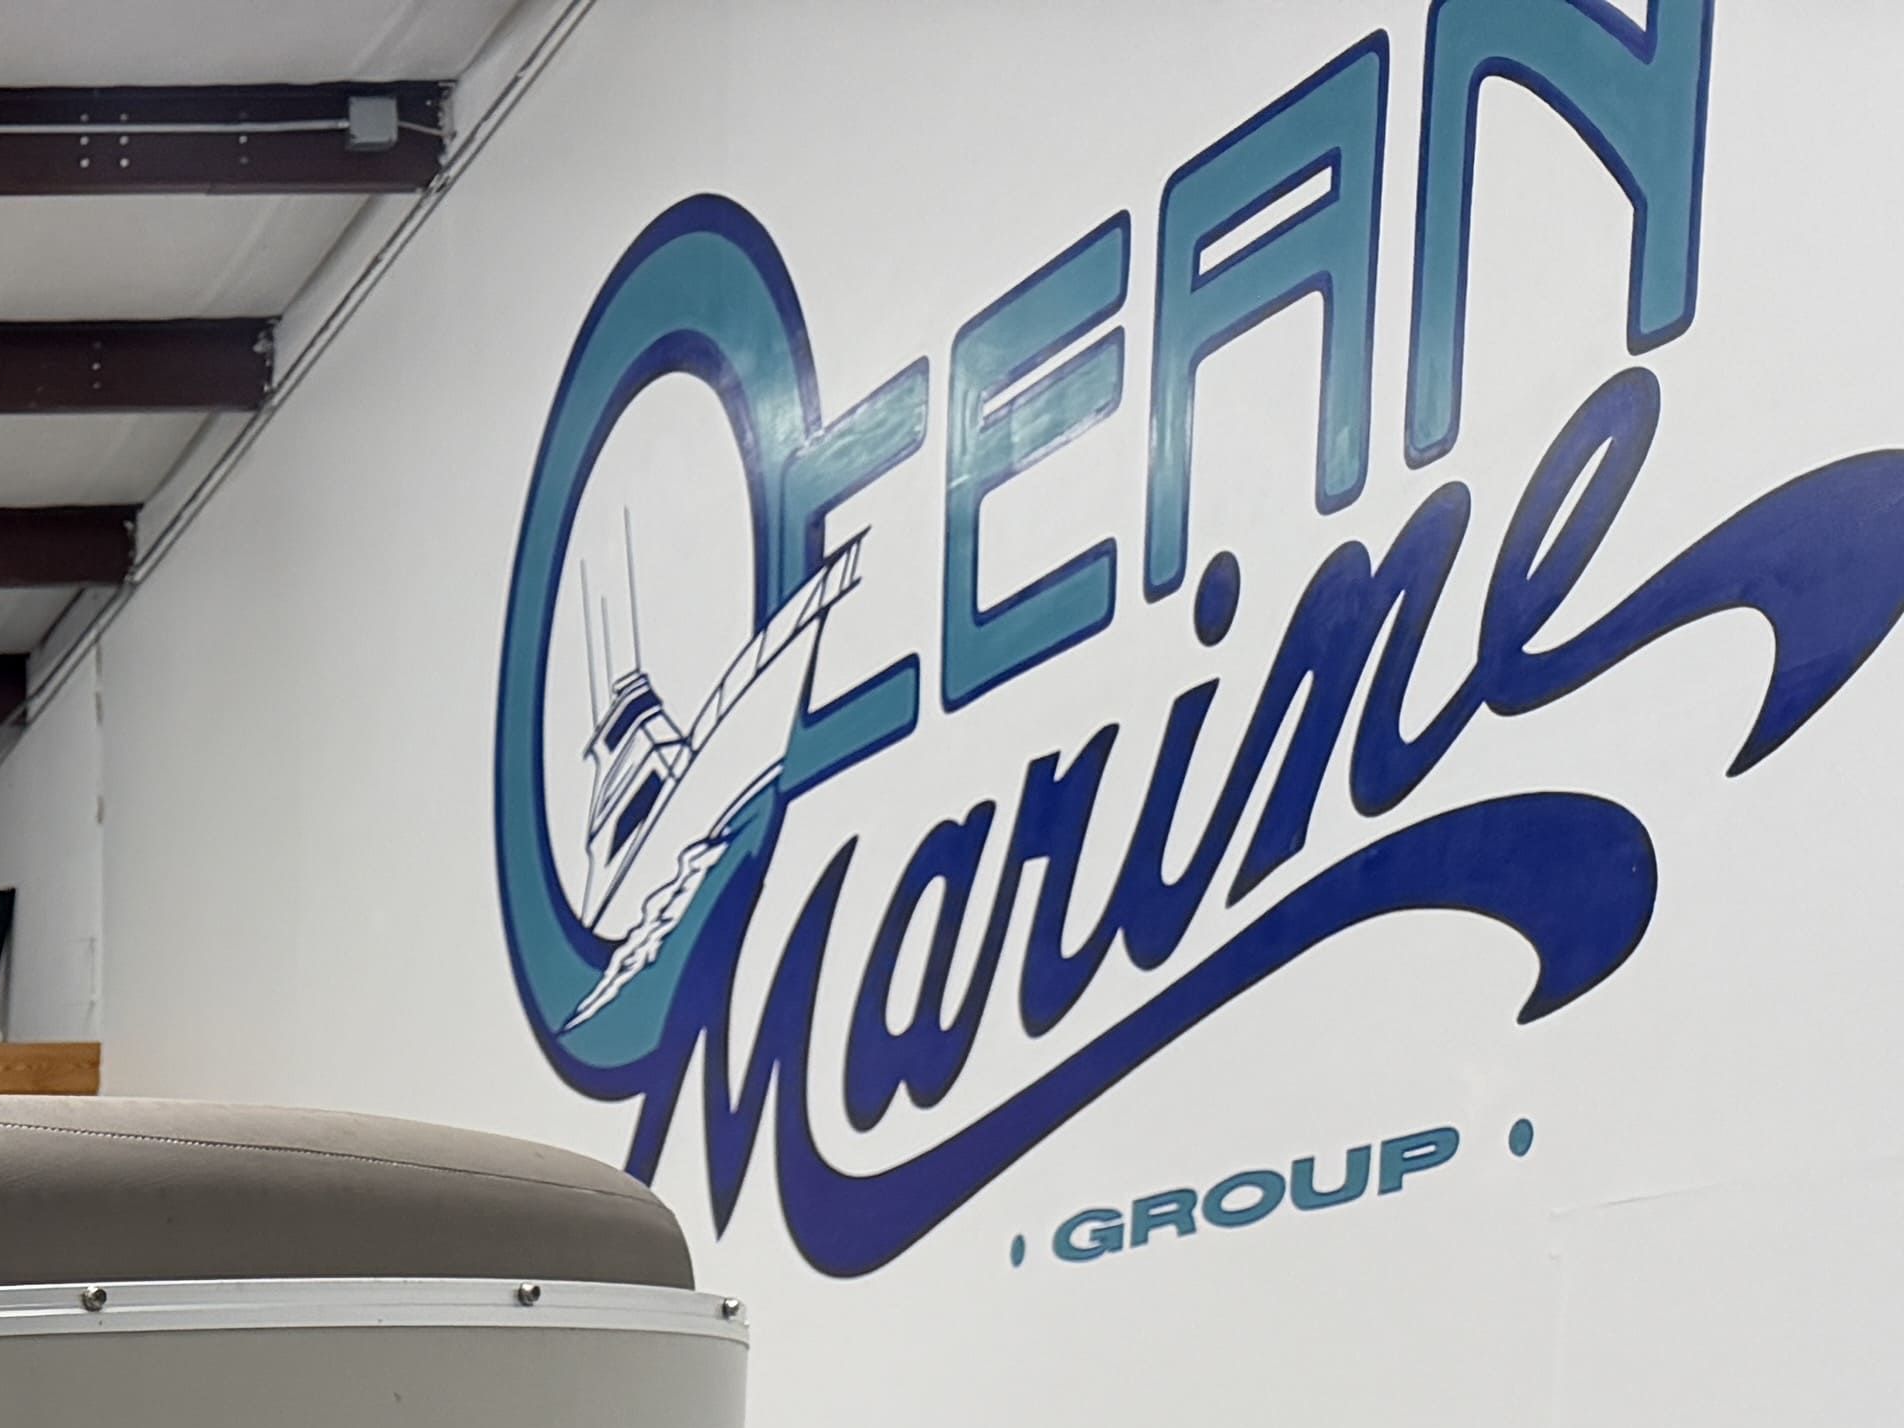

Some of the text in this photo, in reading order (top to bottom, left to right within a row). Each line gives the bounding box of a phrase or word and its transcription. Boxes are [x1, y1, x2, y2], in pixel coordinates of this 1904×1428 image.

[492, 0, 1715, 1099] OCEAN
[622, 366, 1904, 1278] Marine
[1050, 1124, 1462, 1268] GROUP
